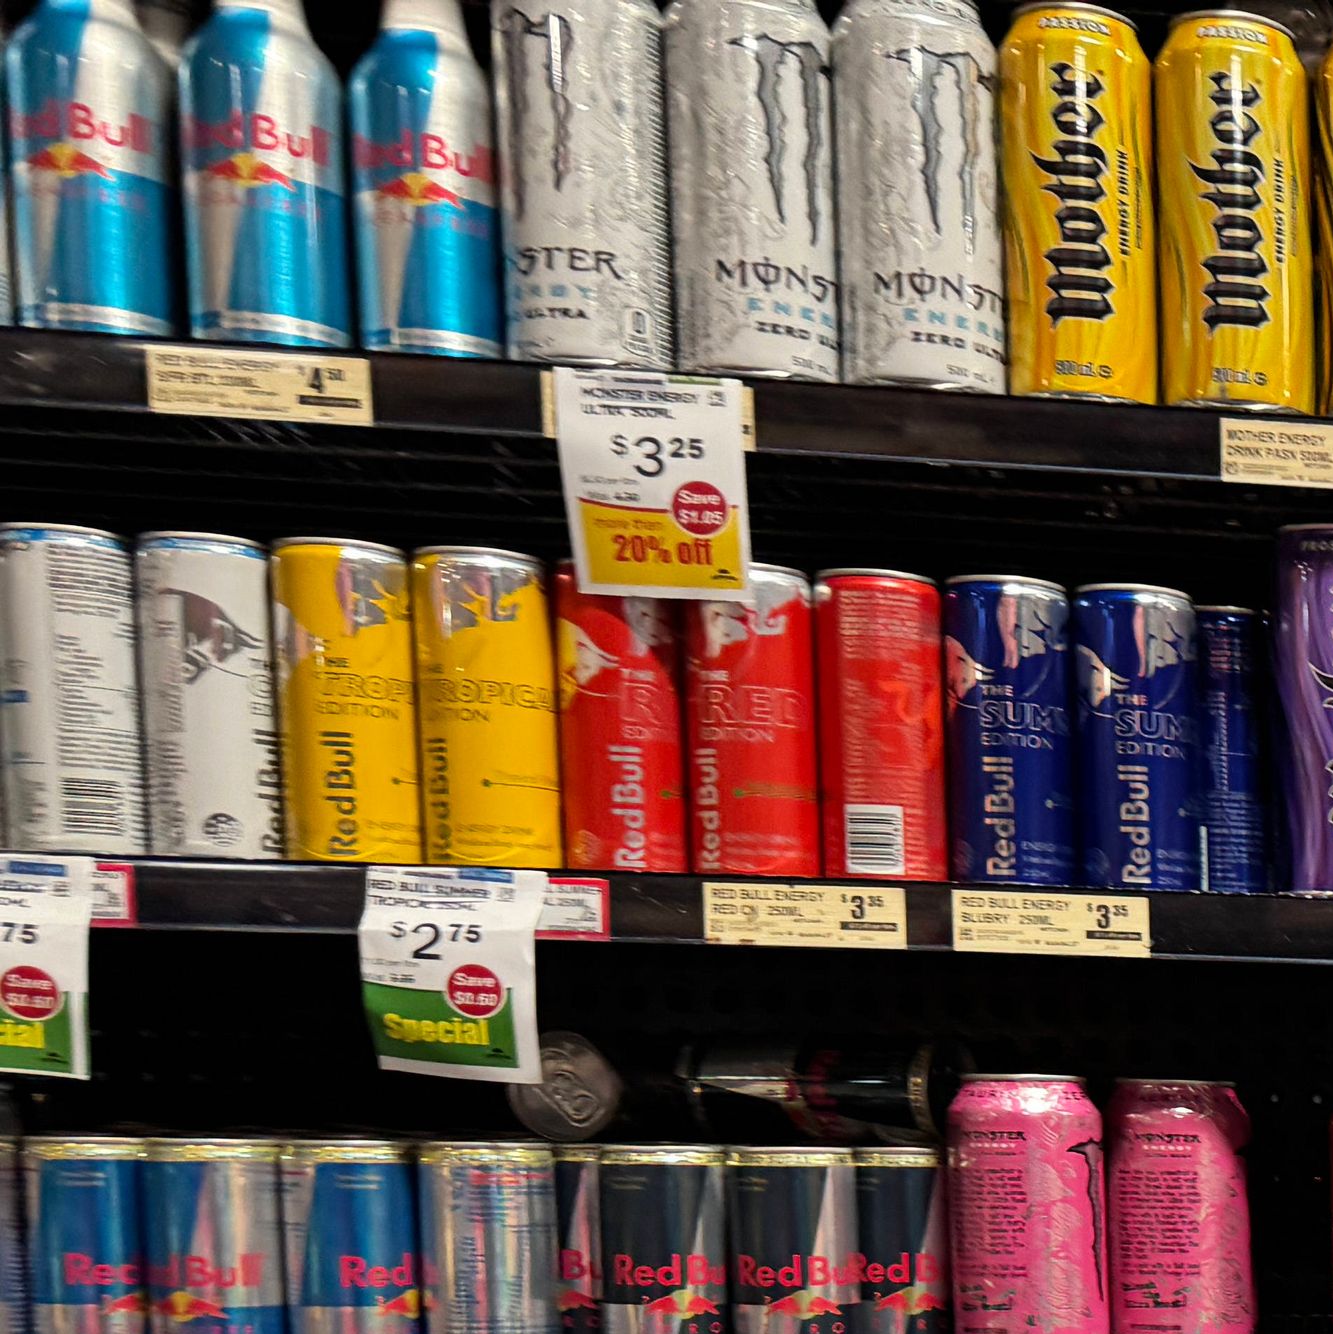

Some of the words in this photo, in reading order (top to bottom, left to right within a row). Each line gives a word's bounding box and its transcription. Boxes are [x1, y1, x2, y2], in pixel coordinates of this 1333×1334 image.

[678, 489, 721, 507] Save
[613, 533, 673, 565] 20%
[678, 538, 713, 566] off
[452, 971, 497, 990] Save
[383, 1012, 490, 1046] Special
[613, 1254, 682, 1287] Red
[737, 1254, 802, 1288] Red
